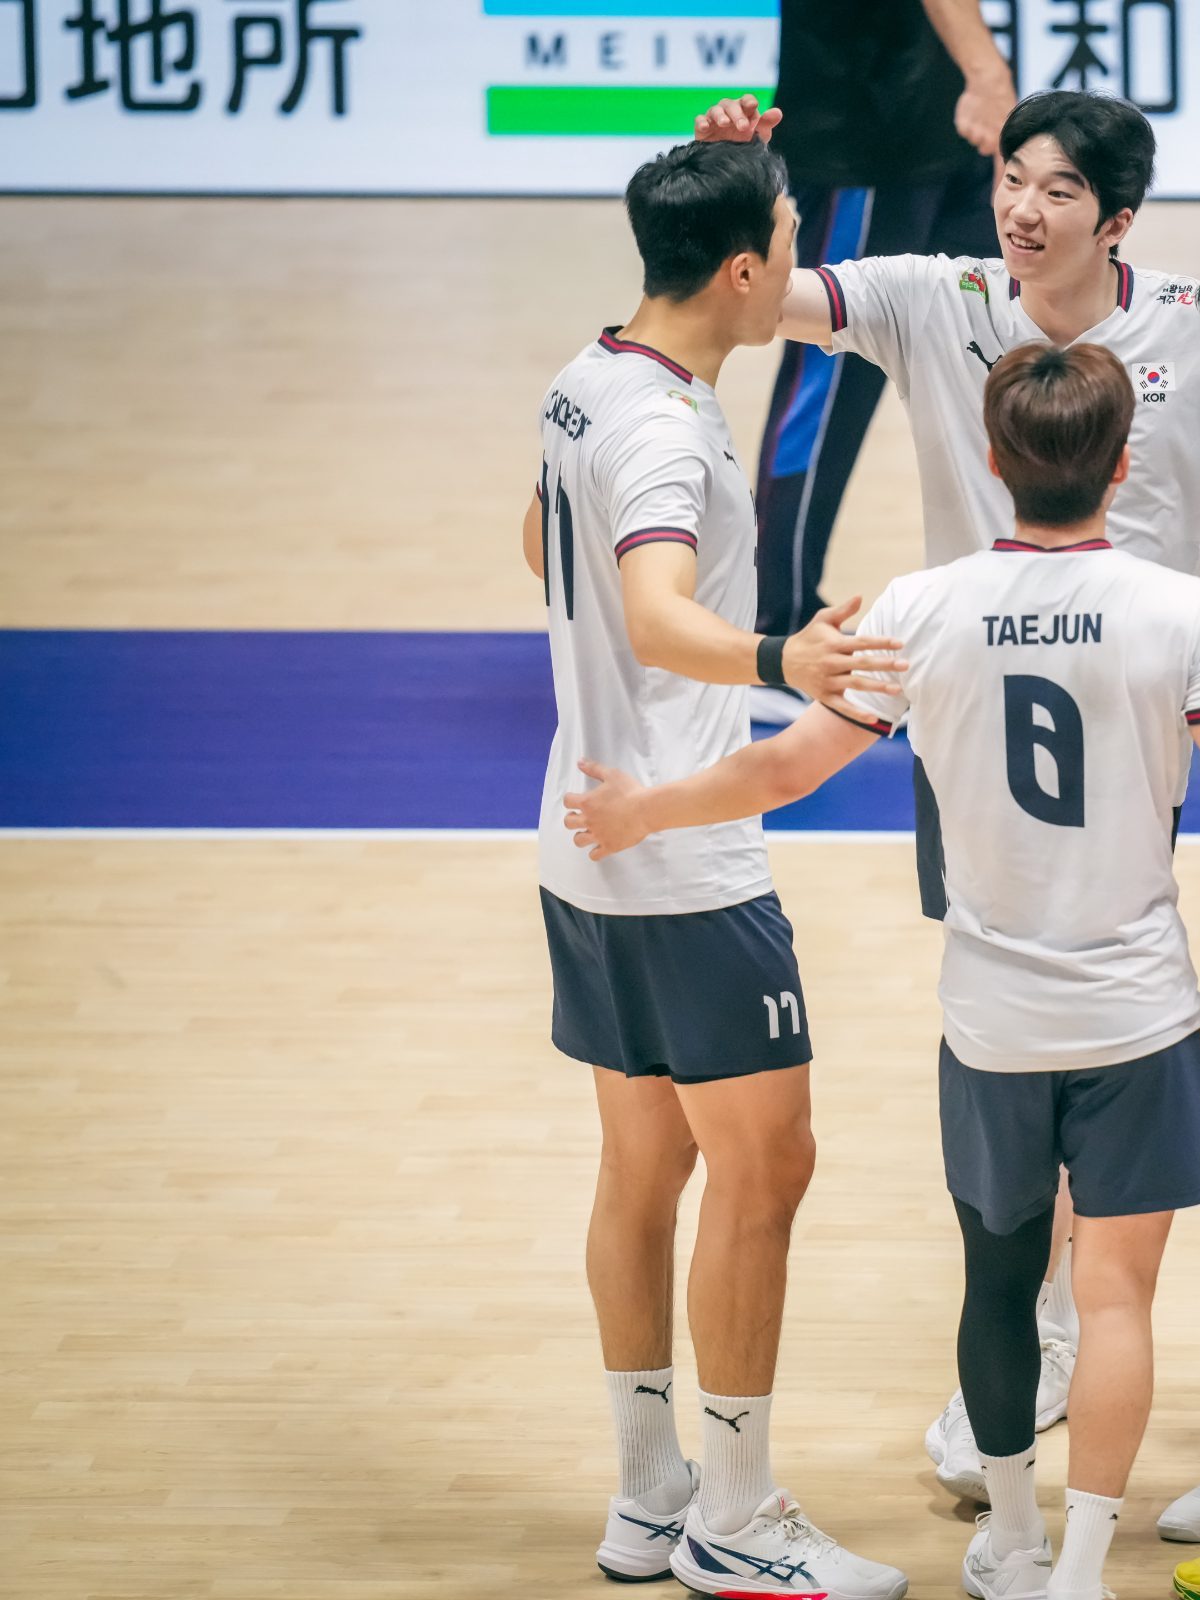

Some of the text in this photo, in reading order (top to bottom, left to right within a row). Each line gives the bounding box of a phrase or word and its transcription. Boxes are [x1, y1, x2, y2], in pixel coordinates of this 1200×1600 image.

[0, 0, 361, 116] 地所
[525, 31, 779, 68] MEIW
[1142, 392, 1166, 403] KOR
[982, 613, 1102, 646] TAEJUN
[763, 991, 801, 1039] 17
